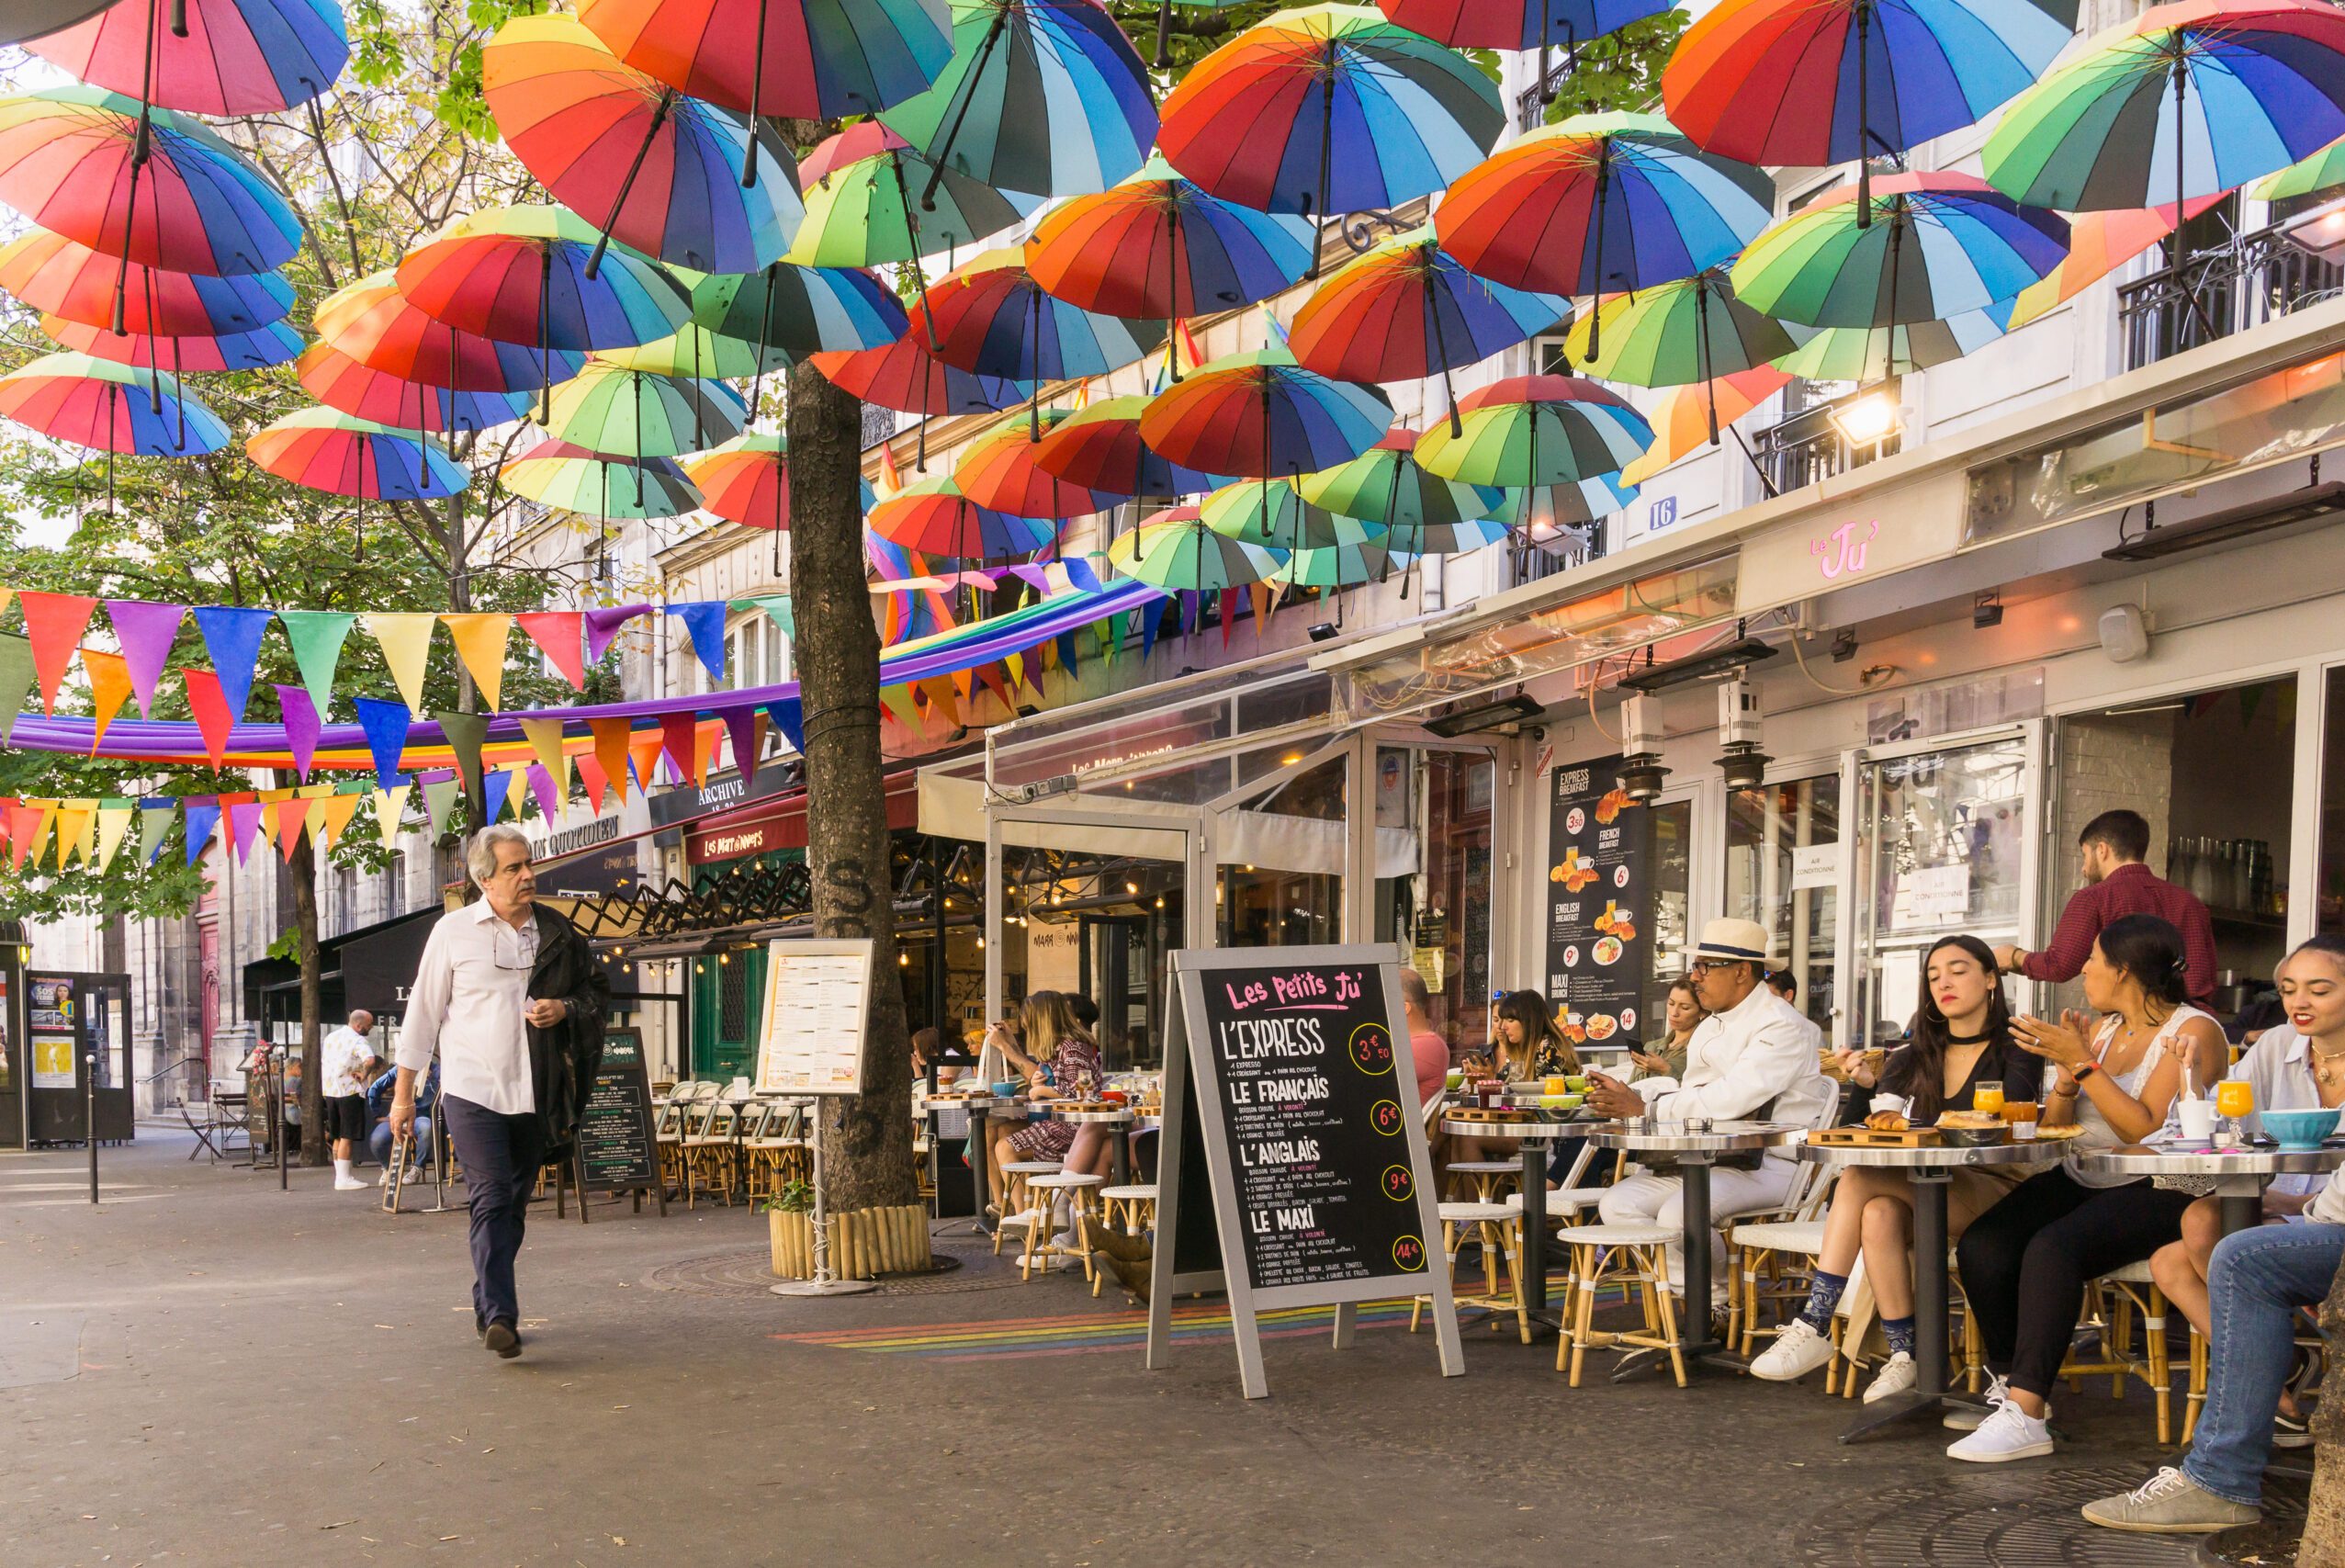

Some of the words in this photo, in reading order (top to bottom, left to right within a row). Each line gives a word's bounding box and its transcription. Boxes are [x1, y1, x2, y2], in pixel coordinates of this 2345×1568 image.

[1652, 499, 1672, 530] 16
[1810, 538, 1828, 556] Le
[1560, 768, 1589, 785] EXPRESS
[699, 779, 745, 806] ARCHIVE
[1559, 780, 1590, 796] BREAKFAST
[549, 814, 619, 856] QUOTIDIEN
[1598, 827, 1620, 841] FRENCH
[705, 840, 716, 857] Les
[1598, 839, 1619, 850] BREAKFAST
[1555, 902, 1580, 915] ENGLISH
[1555, 913, 1579, 923] BREAKFAST
[1551, 974, 1569, 989] MAXI
[1226, 982, 1268, 1010] Les
[1271, 971, 1327, 1005] Petits
[1550, 988, 1568, 998] BRUNCH
[1220, 1017, 1325, 1060] L'EXPRESS
[1236, 1061, 1261, 1069] EXPRESSO
[1236, 1069, 1261, 1077] CROISSANT
[1230, 1081, 1252, 1104] LE
[1257, 1074, 1330, 1105] FRANÇAIS
[1240, 1135, 1321, 1167] L'ANGLAIS
[1250, 1211, 1271, 1233] LE
[1277, 1204, 1315, 1232] MAXI
